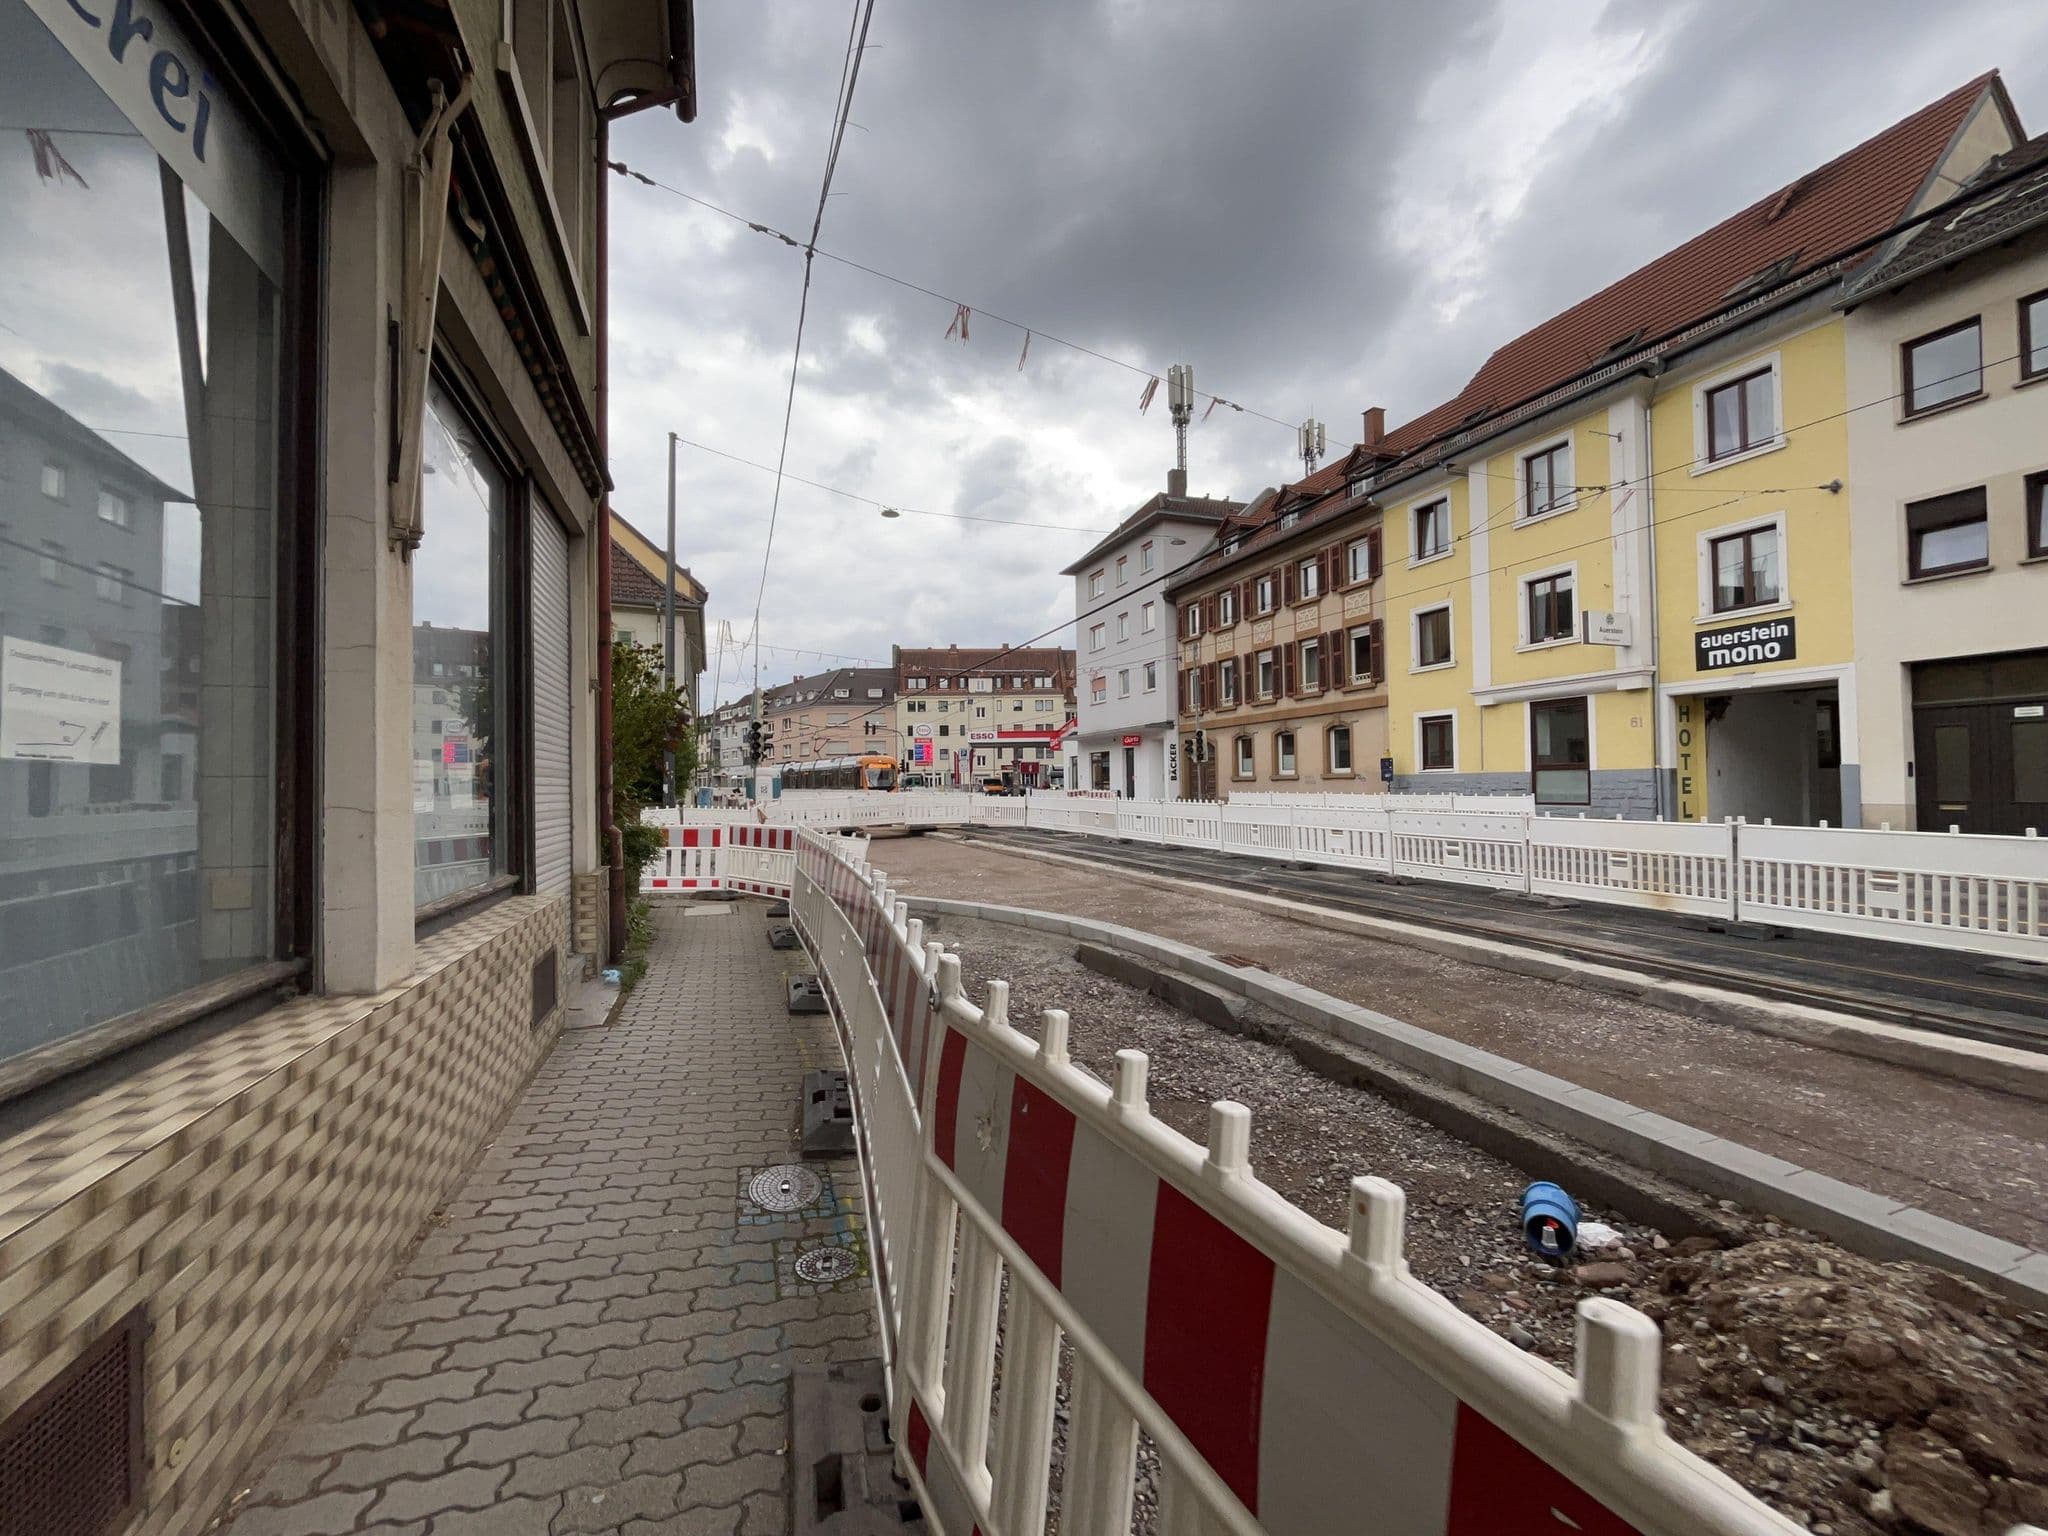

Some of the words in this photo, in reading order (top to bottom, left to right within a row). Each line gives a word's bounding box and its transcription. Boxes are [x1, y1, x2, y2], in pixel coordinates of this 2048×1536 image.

[65, 0, 214, 164] rei
[1700, 622, 1789, 649] auerstein
[1708, 641, 1781, 667] mono
[970, 732, 994, 740] ESSO
[1678, 705, 1693, 819] HOTEL
